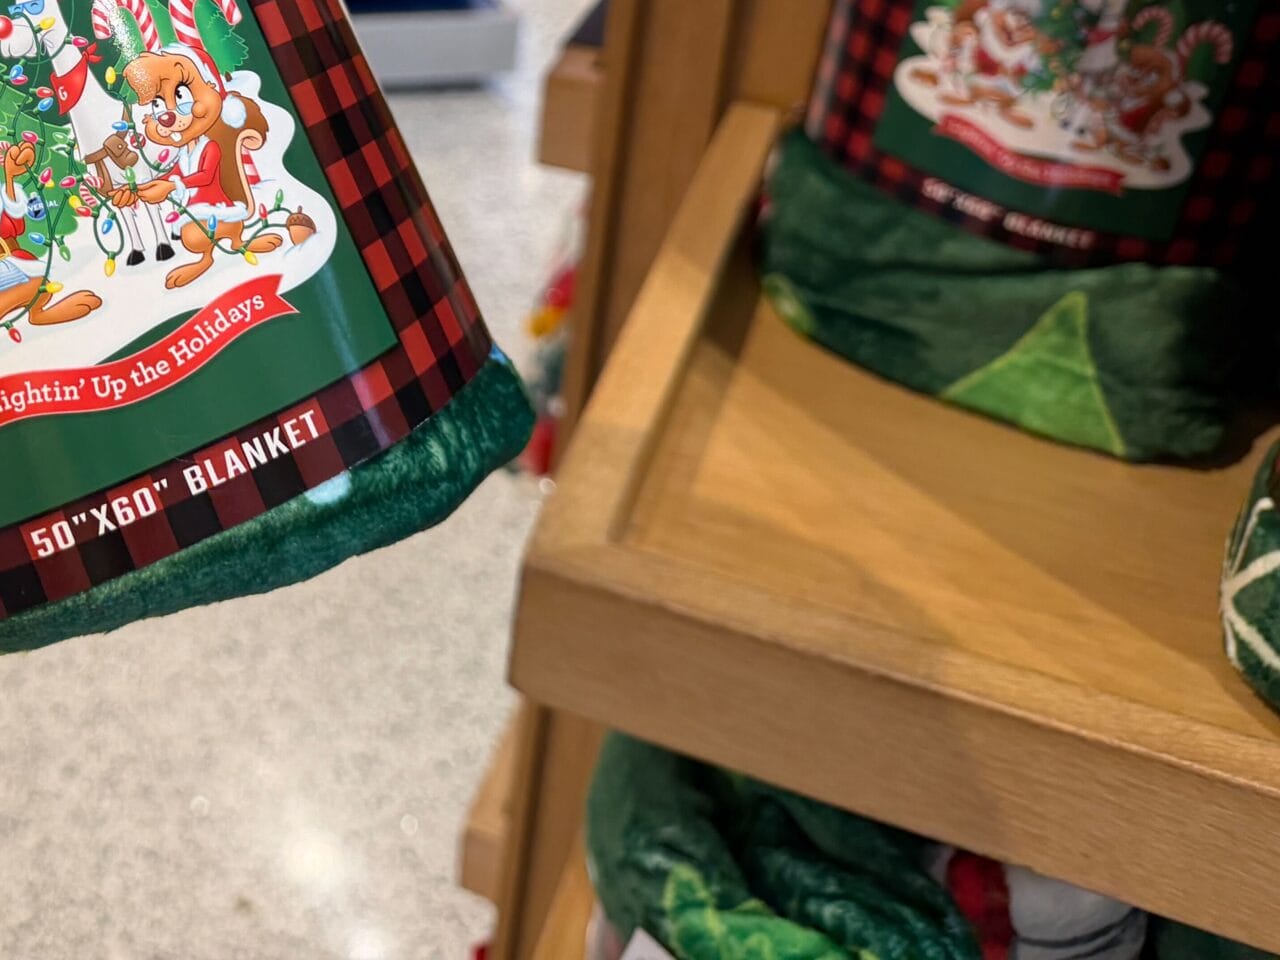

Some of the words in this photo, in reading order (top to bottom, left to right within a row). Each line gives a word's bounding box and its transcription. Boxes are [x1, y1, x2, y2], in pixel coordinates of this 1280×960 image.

[91, 374, 128, 401] Up
[130, 360, 171, 387] the
[168, 294, 265, 367] Holidays
[30, 478, 168, 558] 50"X60"
[182, 409, 322, 497] BLANKET
